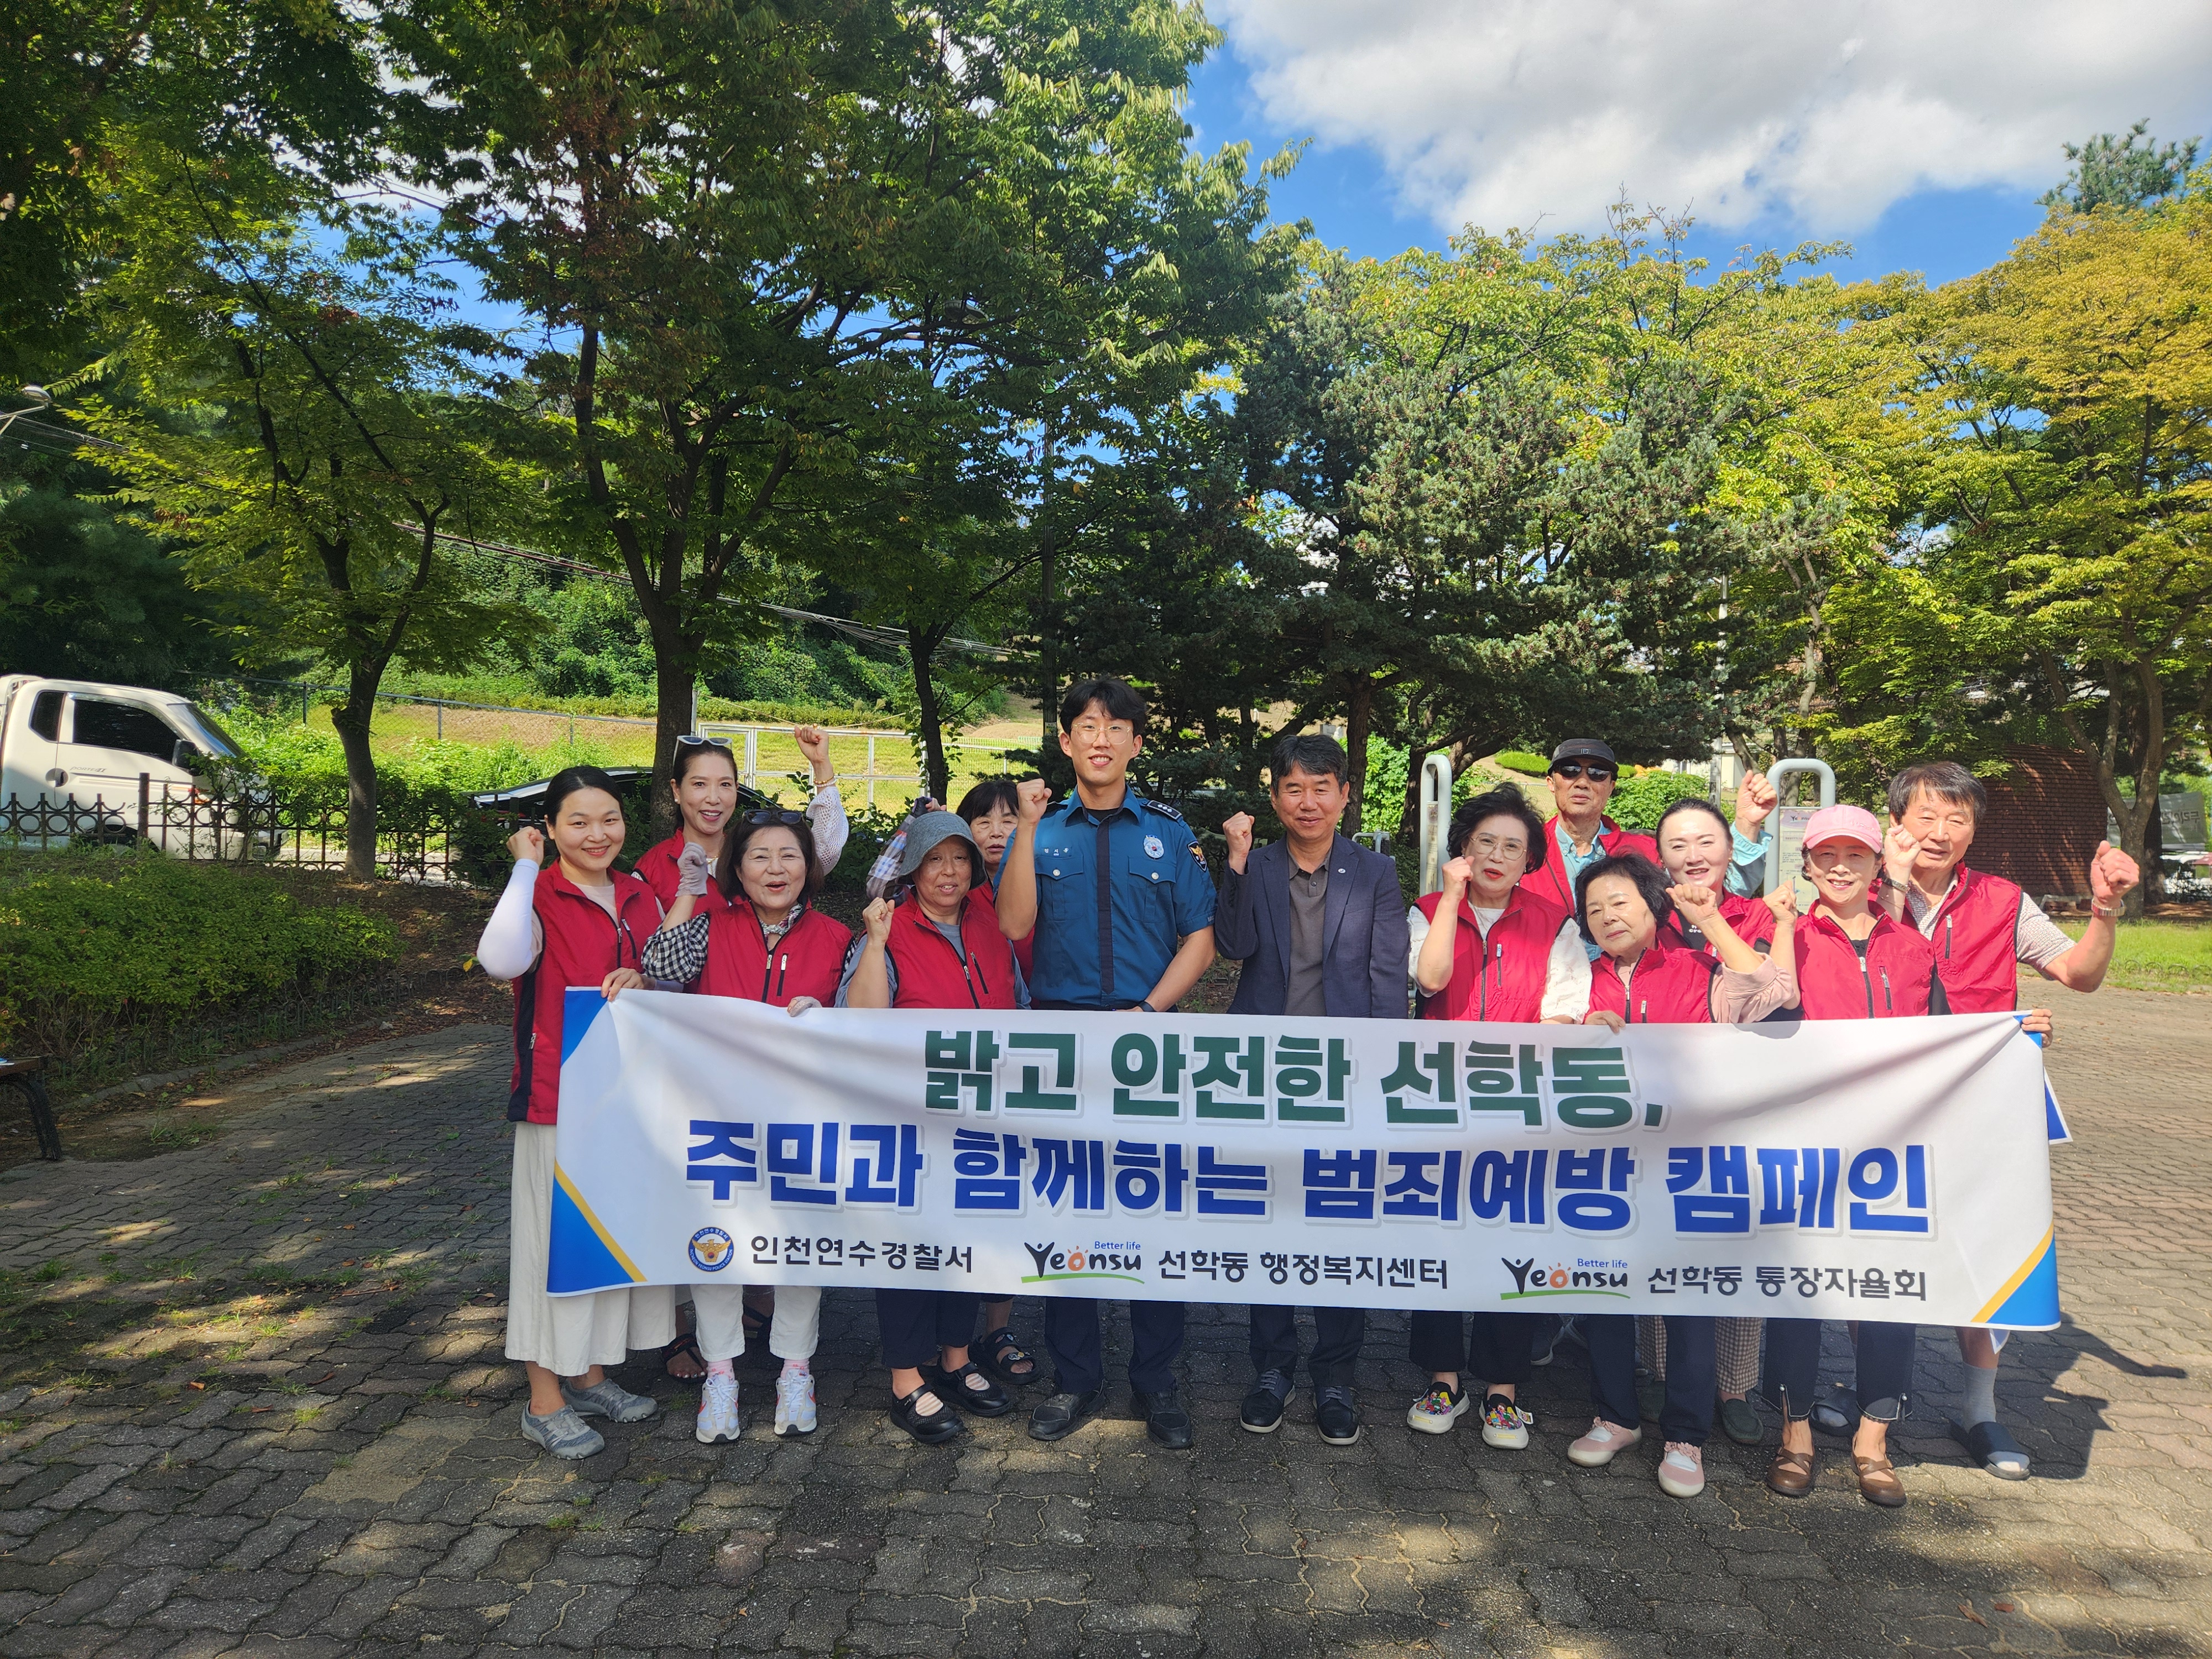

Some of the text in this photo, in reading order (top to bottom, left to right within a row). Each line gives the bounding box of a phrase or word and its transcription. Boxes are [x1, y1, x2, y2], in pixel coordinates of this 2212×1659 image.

[925, 1030, 1662, 1128] 밝고 안전한 선학동,
[686, 1120, 1928, 1233] 주민과 함께하는 범죄예방 캠페인
[751, 1236, 972, 1273] 인천연수경찰서
[1024, 1241, 1141, 1278] Yeonsu
[1094, 1241, 1141, 1250] Better life
[1577, 1258, 1628, 1269] Better life
[1159, 1250, 1448, 1289] 선학동 행정복지센터
[1501, 1257, 1628, 1295] Yeonsu
[1648, 1266, 1926, 1301] 선학동 통장자율회
